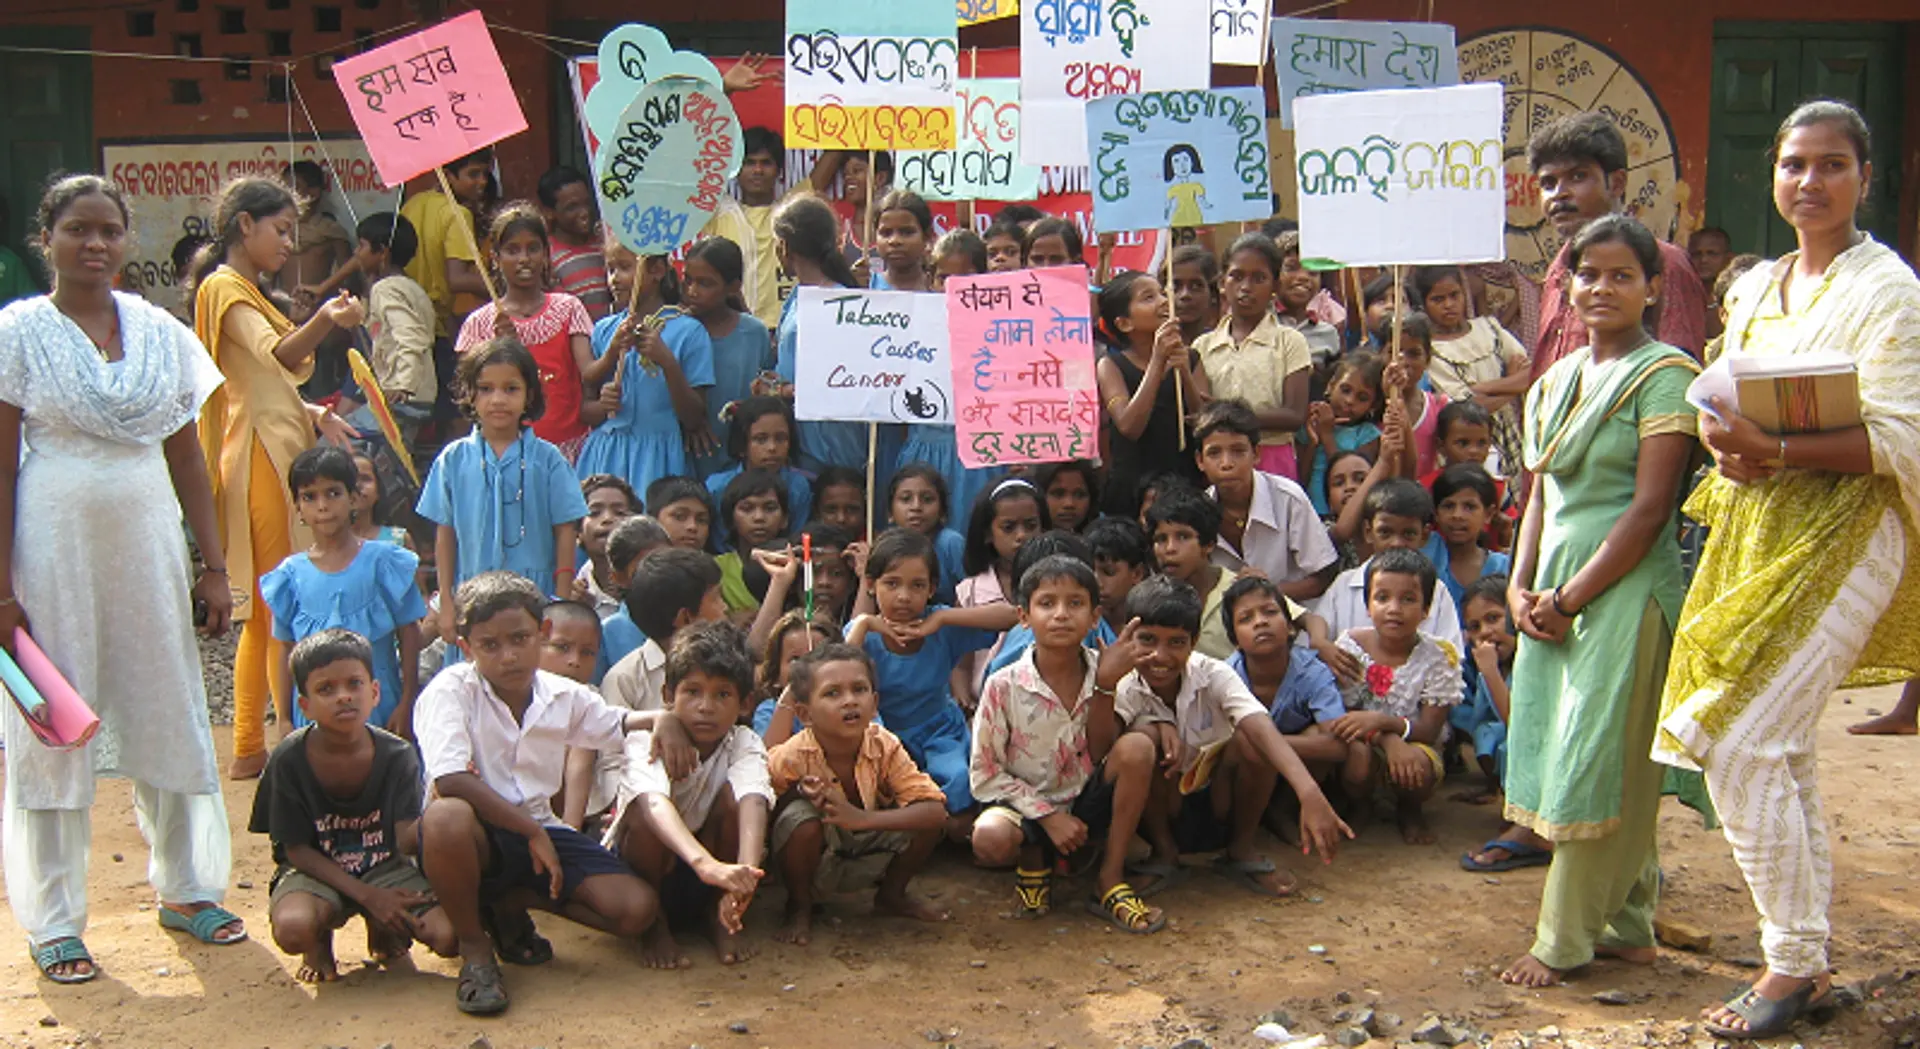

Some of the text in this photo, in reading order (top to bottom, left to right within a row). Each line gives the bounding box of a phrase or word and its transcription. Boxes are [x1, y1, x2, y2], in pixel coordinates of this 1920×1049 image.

[1291, 33, 1376, 79] हमारा
[1385, 31, 1439, 82] देश
[355, 64, 406, 113] हम
[394, 105, 440, 140] एक
[984, 307, 1089, 346] काम लेना
[827, 365, 906, 388] Cancer
